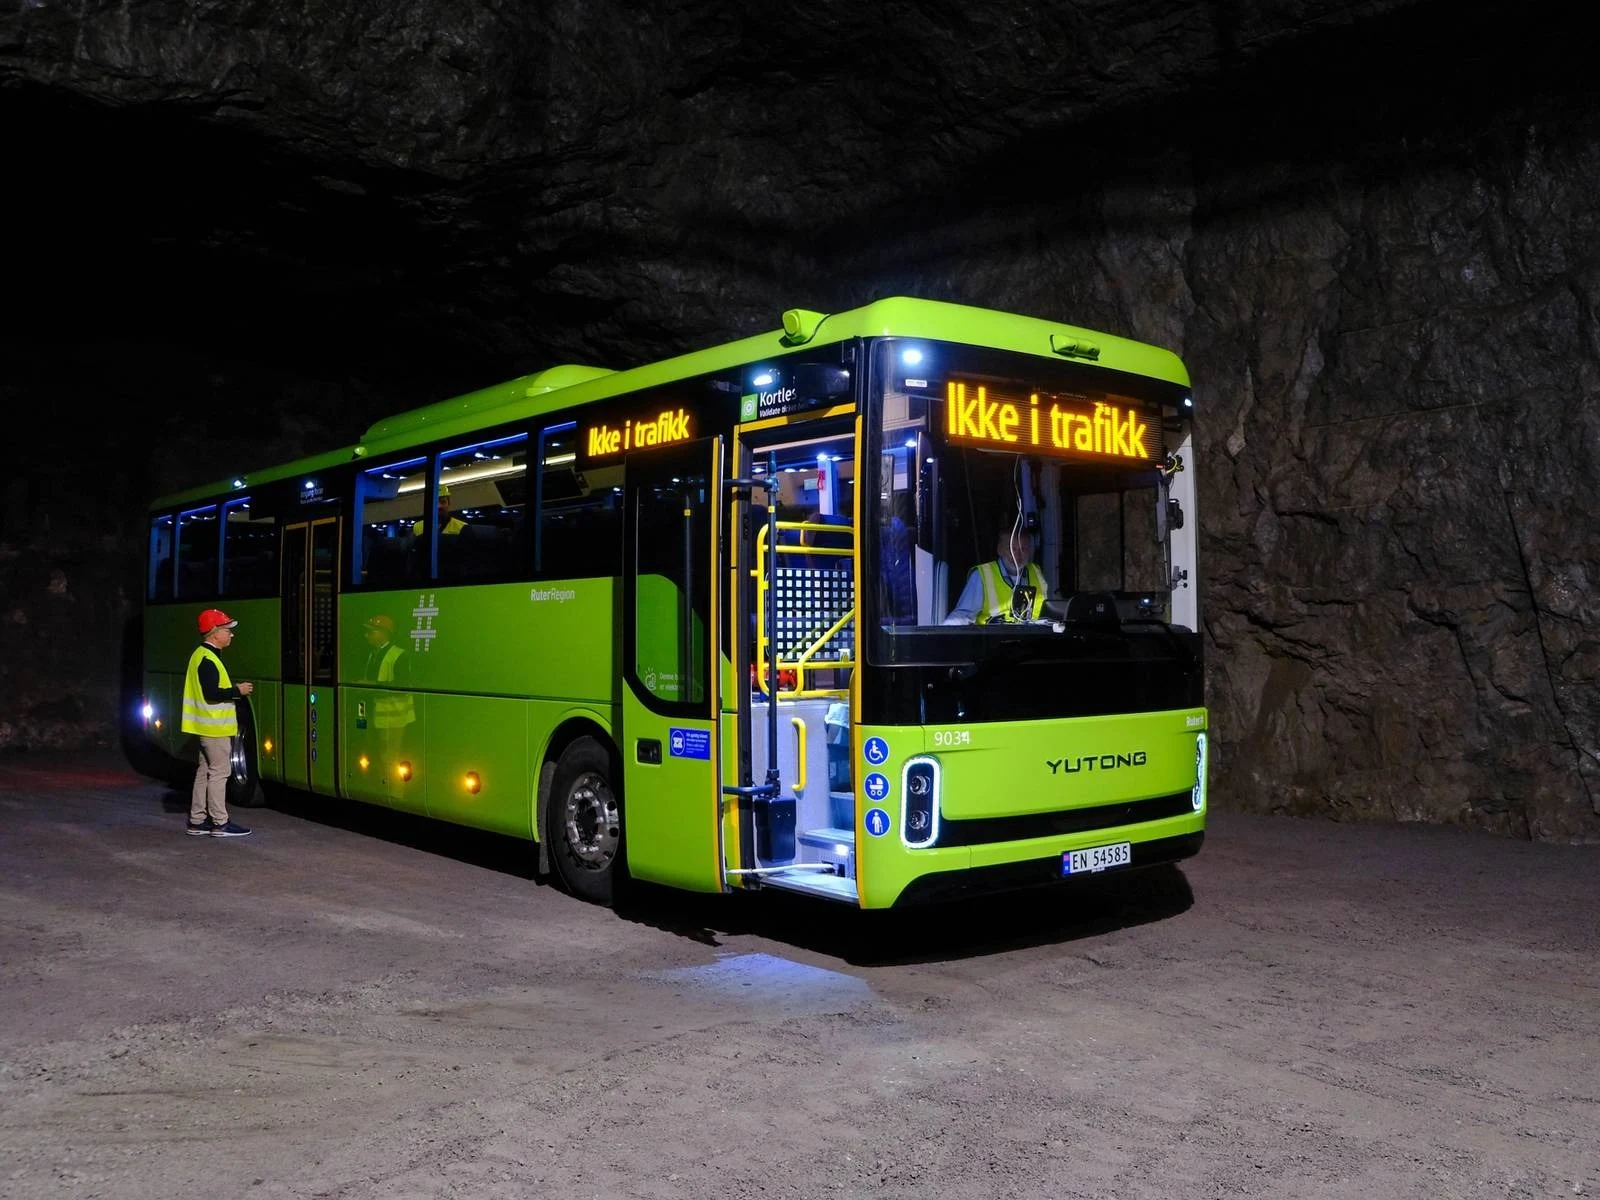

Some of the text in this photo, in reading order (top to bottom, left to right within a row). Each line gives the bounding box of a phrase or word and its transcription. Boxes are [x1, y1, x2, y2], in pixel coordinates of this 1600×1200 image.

[588, 407, 690, 457] Ikke i trafikk
[948, 381, 1149, 460] Ikke i trafikk
[530, 587, 576, 604] RuterRegion
[1046, 751, 1147, 775] YUTONG
[1072, 845, 1128, 870] EN 54585
